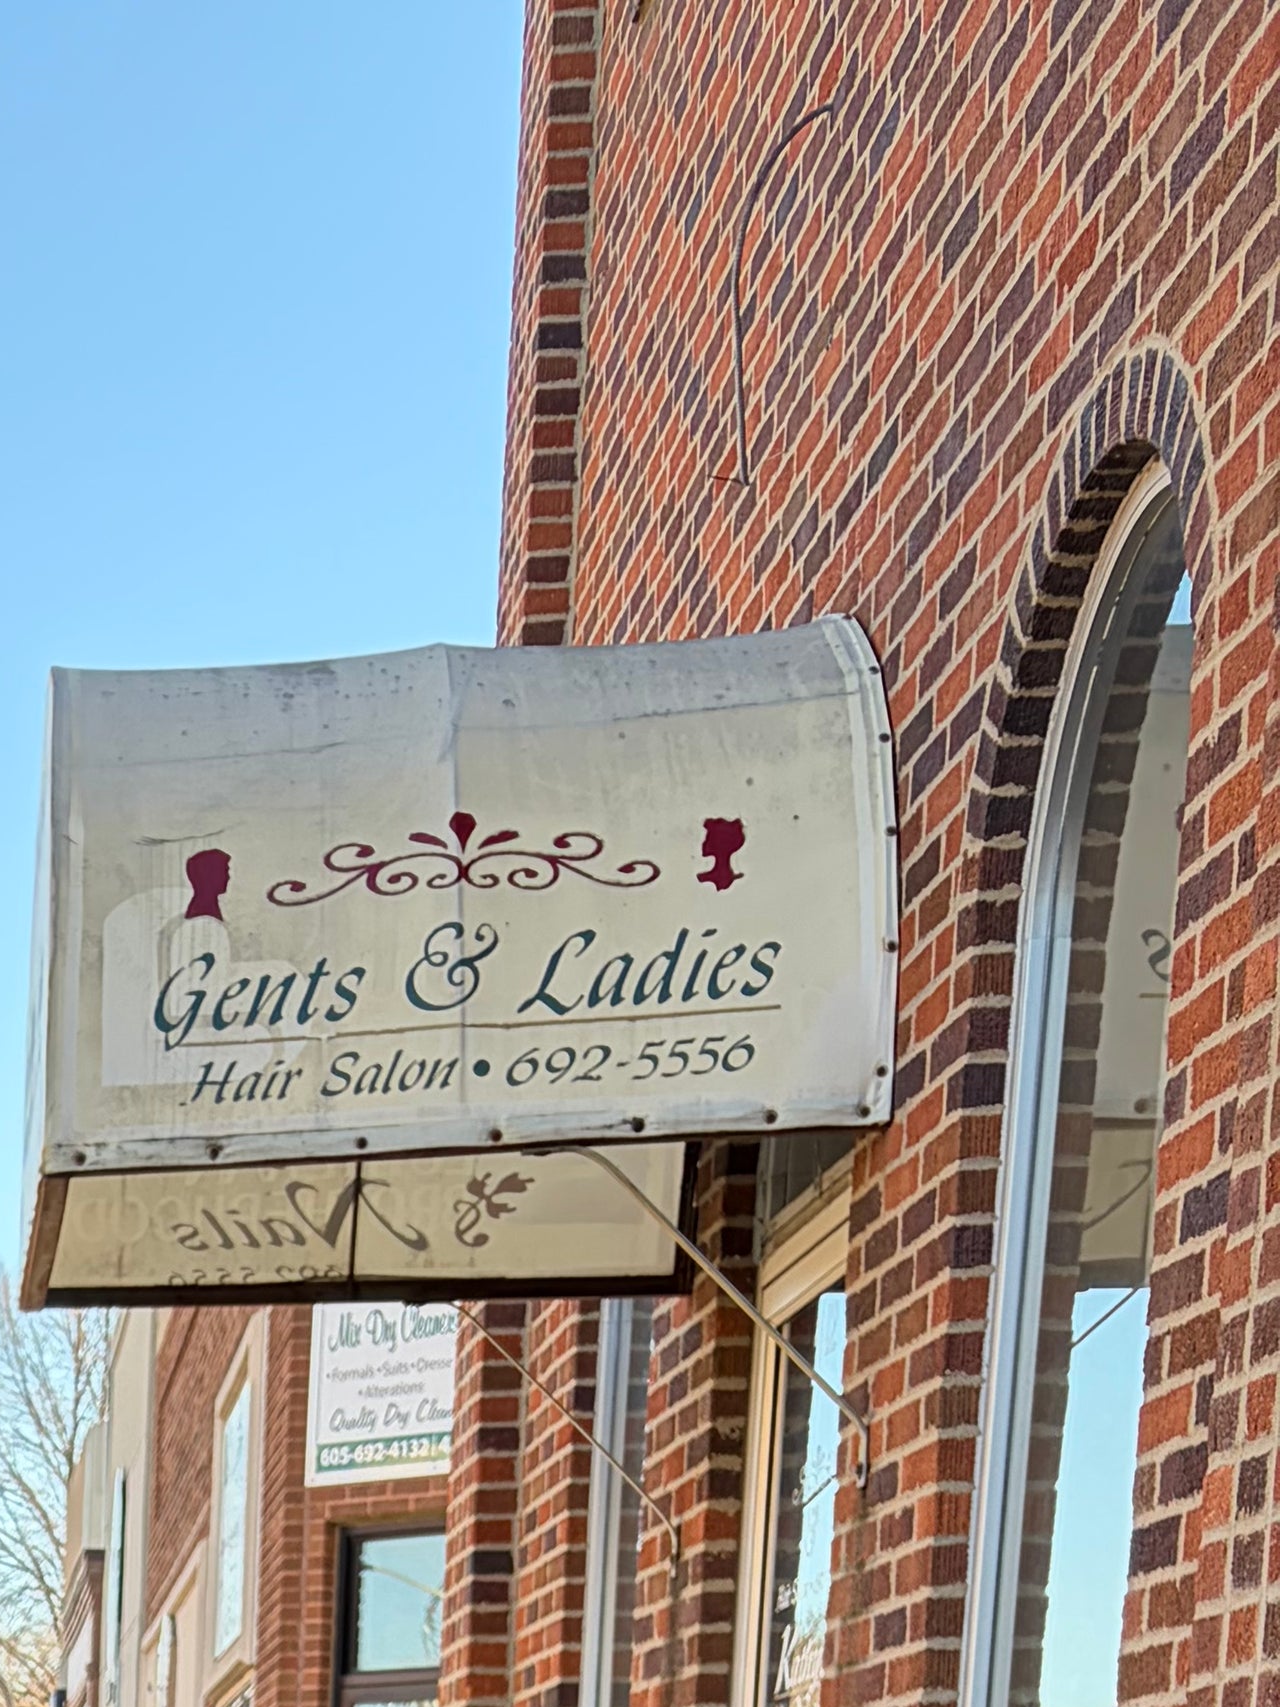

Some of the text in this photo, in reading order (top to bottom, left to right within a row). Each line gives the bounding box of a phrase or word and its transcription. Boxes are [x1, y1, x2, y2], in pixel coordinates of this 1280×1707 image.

[154, 921, 782, 1052] Gents & Ladies
[191, 1034, 756, 1105] Hair Salon 692-5556
[365, 1309, 397, 1353] Dry
[416, 1357, 452, 1373] Dresse
[365, 1382, 425, 1398] Alterations
[329, 1405, 378, 1433] Quality
[383, 1402, 411, 1429] Dry
[320, 1437, 429, 1467] 605-692-4132
